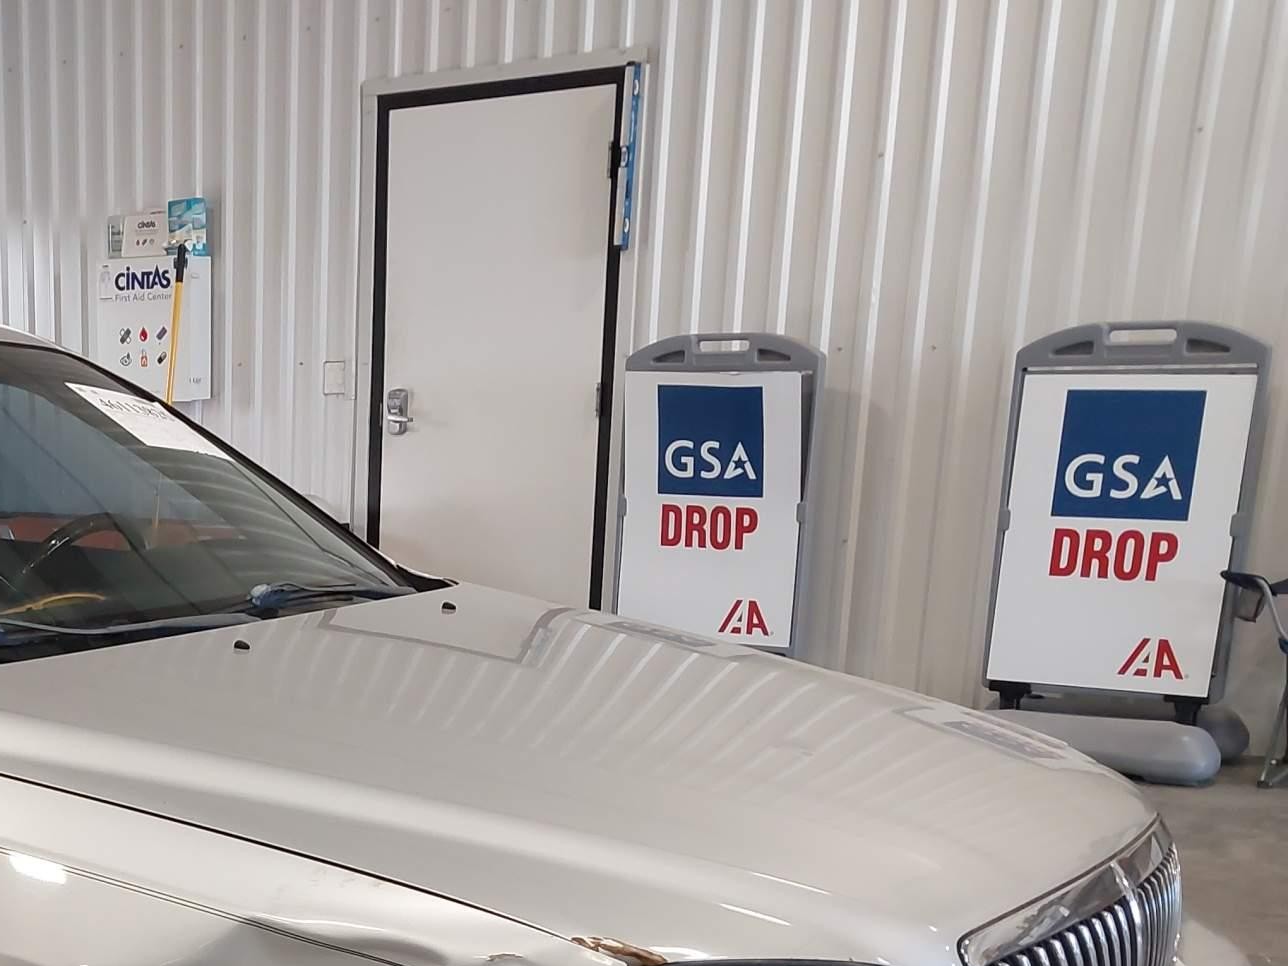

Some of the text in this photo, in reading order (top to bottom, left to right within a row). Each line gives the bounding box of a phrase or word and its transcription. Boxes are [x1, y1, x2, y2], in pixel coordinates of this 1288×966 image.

[115, 292, 172, 303] First Aid Center
[665, 440, 757, 480] GSA
[1064, 453, 1182, 501] GSA
[661, 503, 759, 550] DROP
[1048, 528, 1179, 582] DROP
